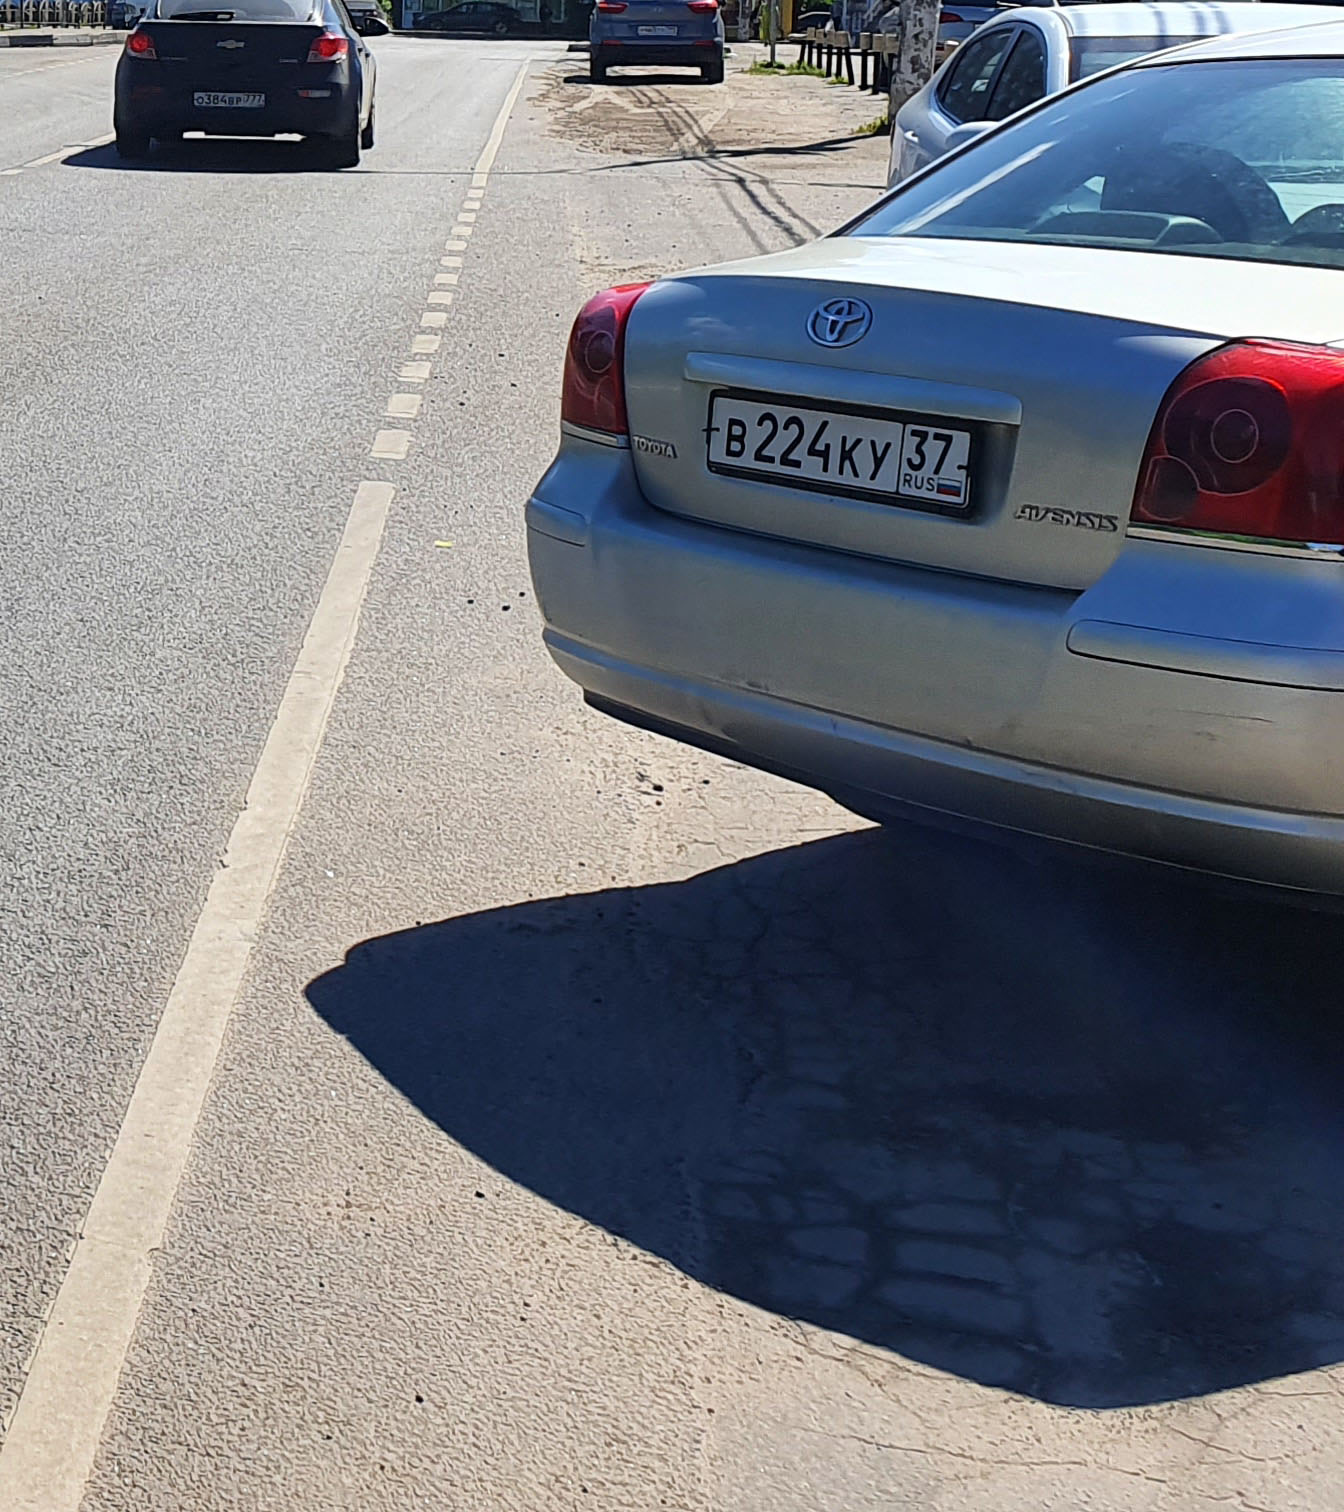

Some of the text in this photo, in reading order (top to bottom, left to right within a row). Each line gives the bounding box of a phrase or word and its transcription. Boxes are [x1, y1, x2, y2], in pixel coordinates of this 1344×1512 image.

[632, 435, 678, 459] TOYOTA
[725, 412, 953, 481] В224КУ 37
[903, 473, 936, 492] RUS
[1014, 504, 1119, 532] AVENSIS
